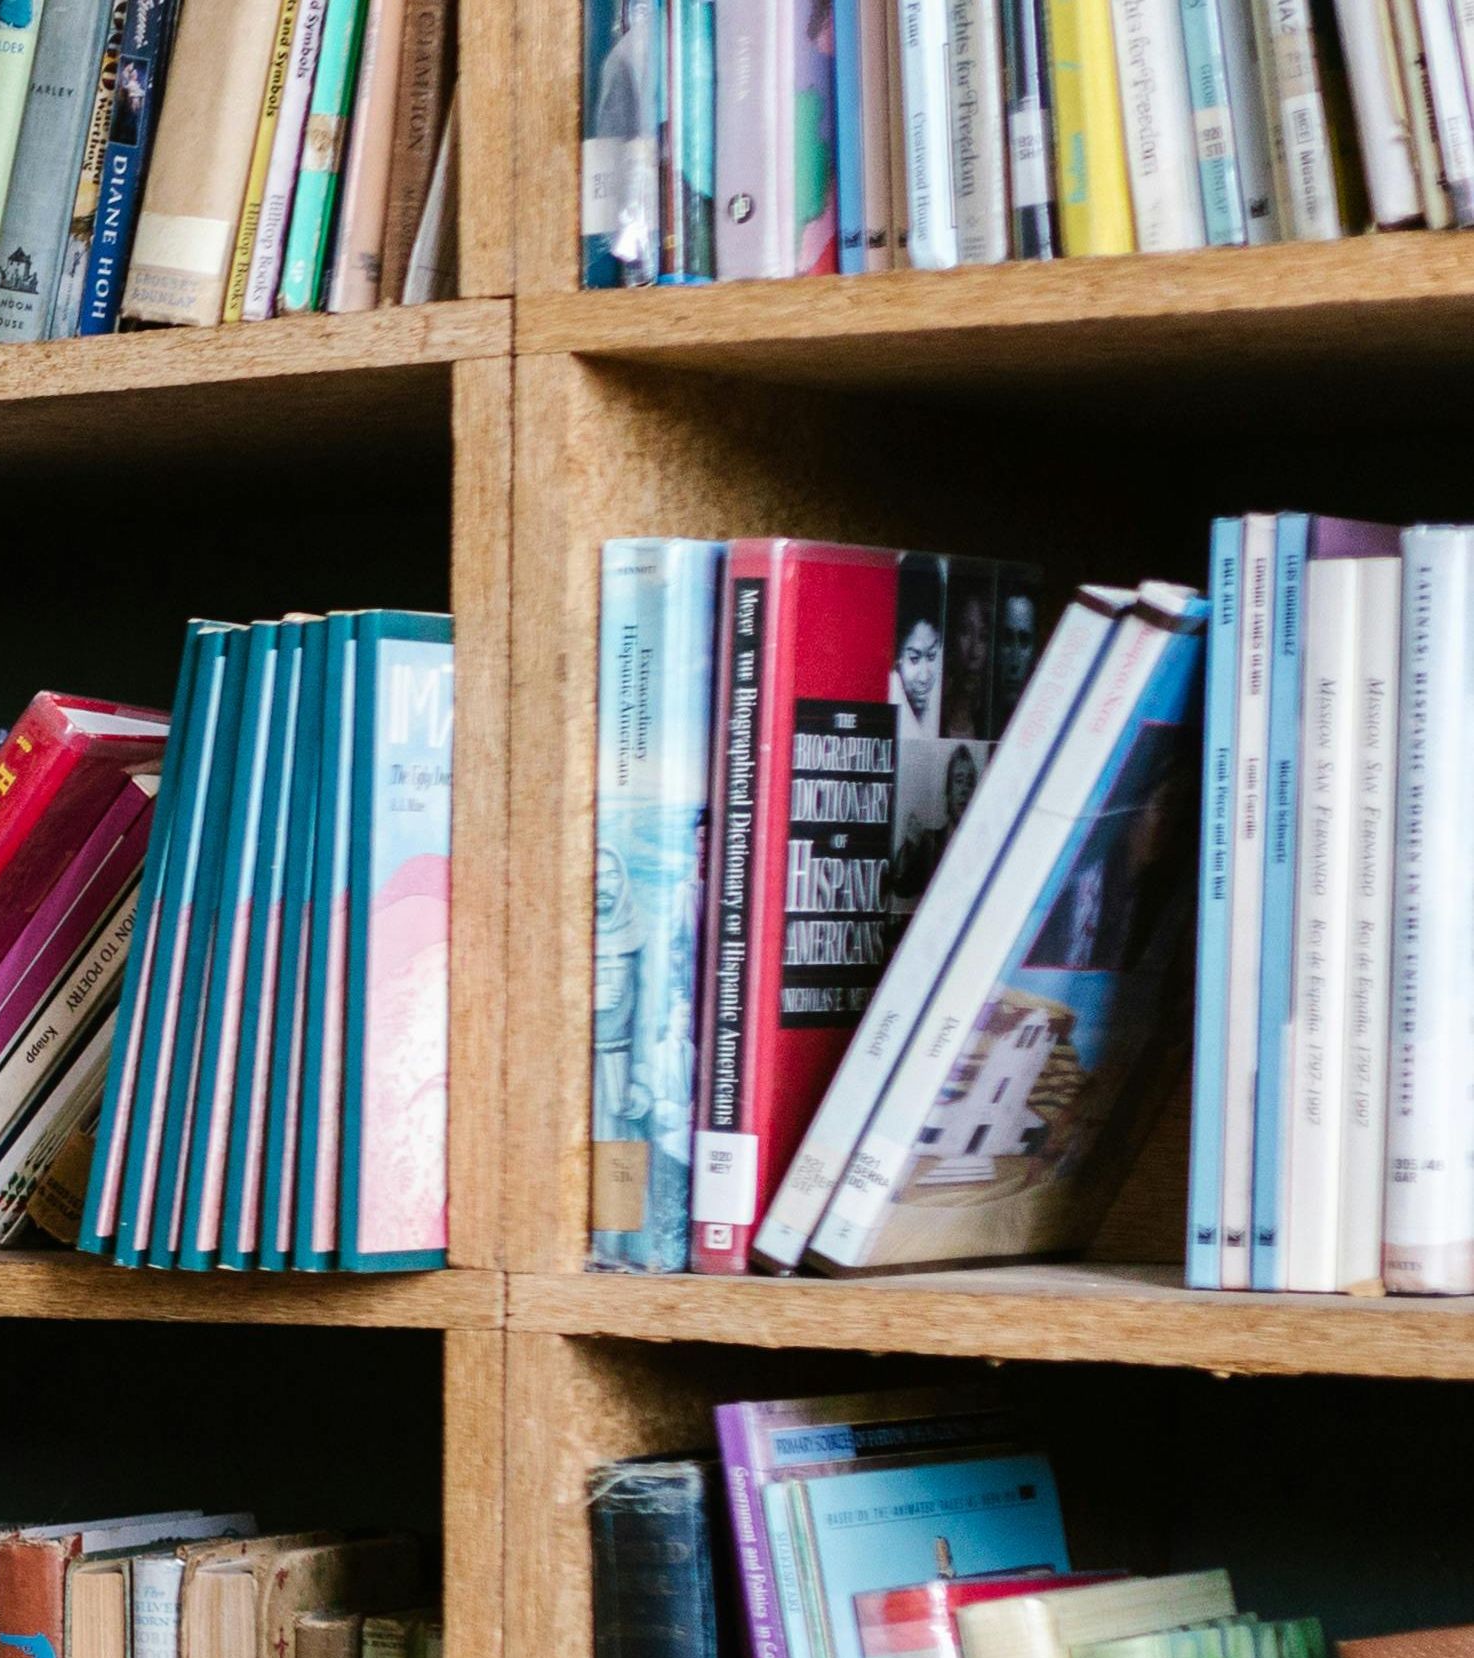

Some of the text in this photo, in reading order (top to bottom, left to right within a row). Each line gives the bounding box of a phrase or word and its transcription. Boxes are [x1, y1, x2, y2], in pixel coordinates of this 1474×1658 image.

[261, 15, 295, 118] and Symbols
[293, 13, 321, 79] Symbols
[407, 10, 438, 151] CHAMPION
[954, 61, 979, 197] for Freedom
[912, 112, 928, 241] Crestwood House
[90, 154, 129, 319] DIANE HOH
[227, 201, 261, 310] Hilltop Books
[250, 192, 286, 303] Hilltop Books
[734, 587, 762, 637] Meyer
[1248, 557, 1267, 695] EDWARD JAMES OLMOS
[615, 625, 638, 786] Hispanic Americans
[630, 647, 656, 761] Extraordinary
[834, 713, 858, 729] THE
[1410, 672, 1432, 773] HISPANIC
[726, 686, 757, 805] Biographical
[792, 733, 895, 773] BIOGRAPHICAL
[790, 779, 893, 823] DICTIONARY
[833, 833, 850, 849] OF
[1272, 759, 1291, 863] Michael Schwartz
[1407, 783, 1427, 864] WOMEN
[721, 811, 751, 910] Dictionary
[784, 839, 891, 914] HISPANIC
[1406, 872, 1423, 896] IN
[782, 920, 885, 966] AMERICANS
[1404, 904, 1422, 945] THE
[64, 940, 119, 1014] TO POETRY
[716, 940, 744, 1022] Hispanic
[1401, 953, 1420, 1035] UNITED
[23, 1023, 59, 1067] Knapp
[711, 1026, 740, 1125] Americans
[1398, 1042, 1417, 1117] STATES
[730, 1464, 759, 1543] Government
[742, 1546, 764, 1571] and
[746, 1573, 771, 1618] Politics
[754, 1625, 775, 1640] in
